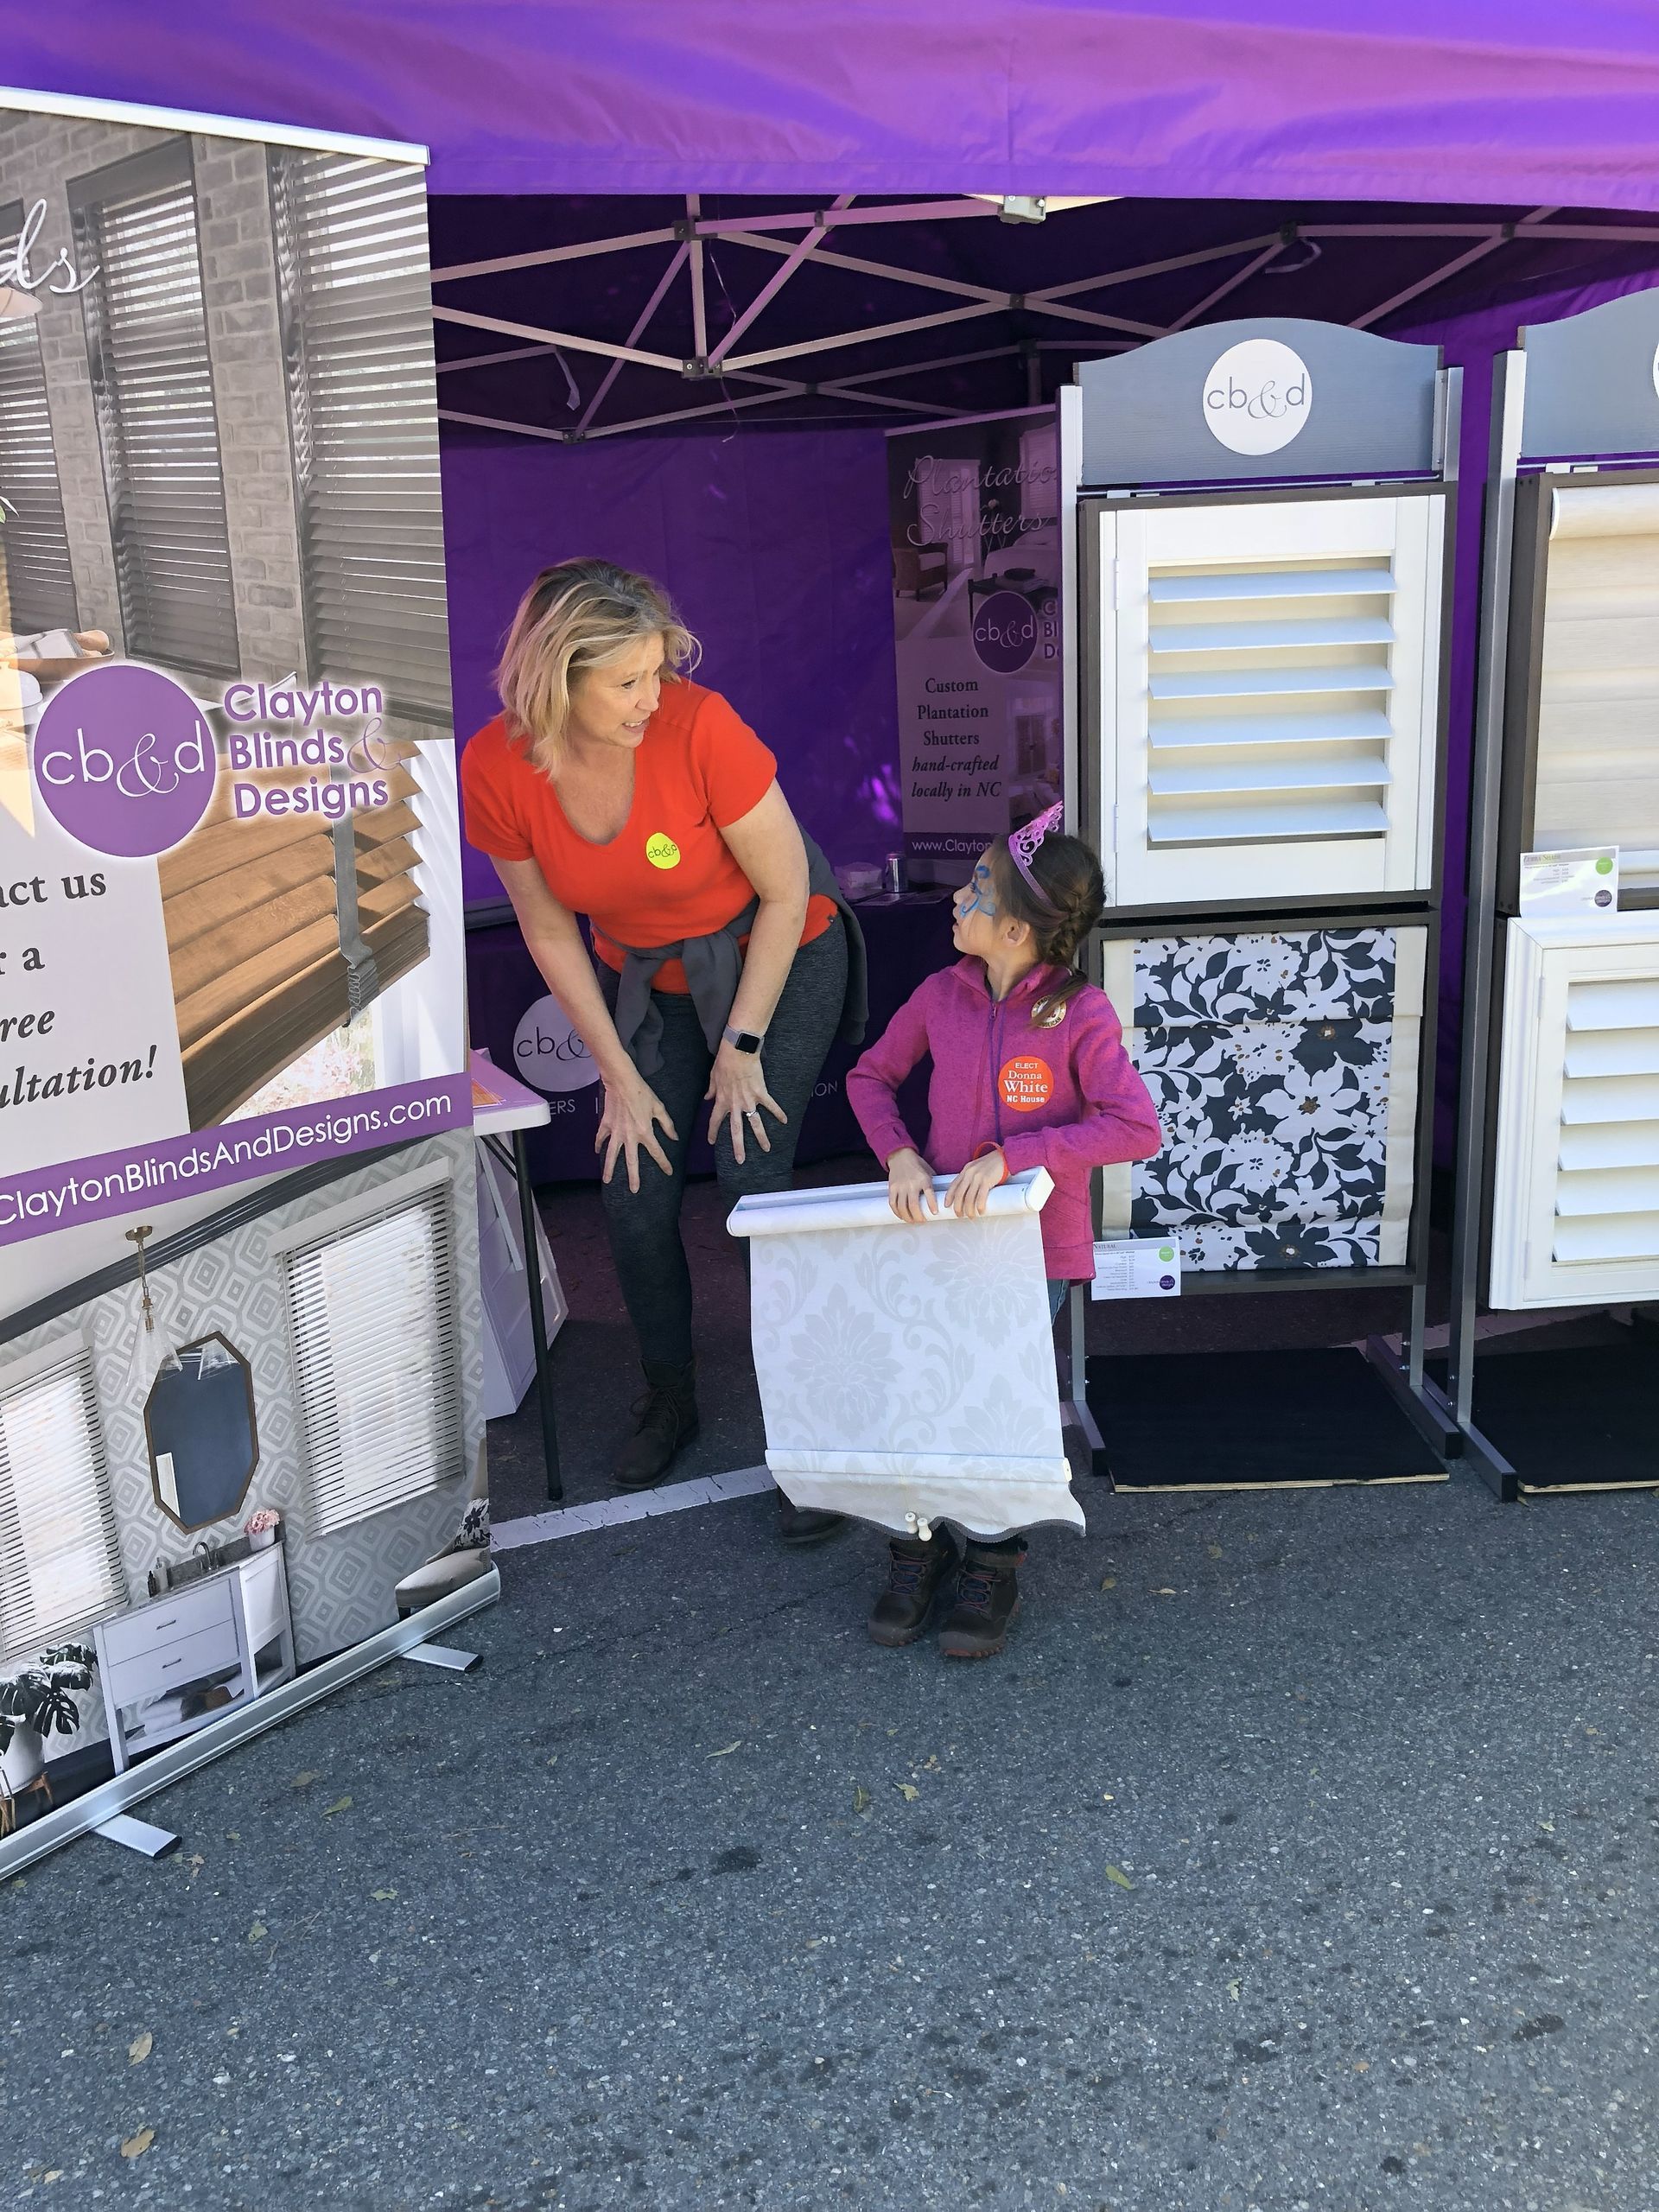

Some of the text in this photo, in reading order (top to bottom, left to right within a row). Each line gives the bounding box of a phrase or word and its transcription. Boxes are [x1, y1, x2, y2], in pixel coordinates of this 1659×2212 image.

[1206, 372, 1306, 419] cb&d
[903, 454, 1058, 499] Plantatio
[906, 504, 1050, 546] Shutters
[975, 614, 1034, 648] cb&d
[925, 677, 979, 694] Custom
[224, 682, 384, 727] Clayton
[917, 704, 988, 720] Plantation
[229, 717, 402, 774] Blinds &
[923, 731, 980, 746] Shutters
[41, 719, 206, 798] cb&d
[912, 754, 1000, 776] hand-crafted
[233, 777, 389, 820] Designs
[911, 781, 1002, 802] locally in NC
[61, 872, 106, 899] us
[22, 947, 46, 971] a
[1004, 1079, 1048, 1093] White
[1007, 1070, 1042, 1079] Donna
